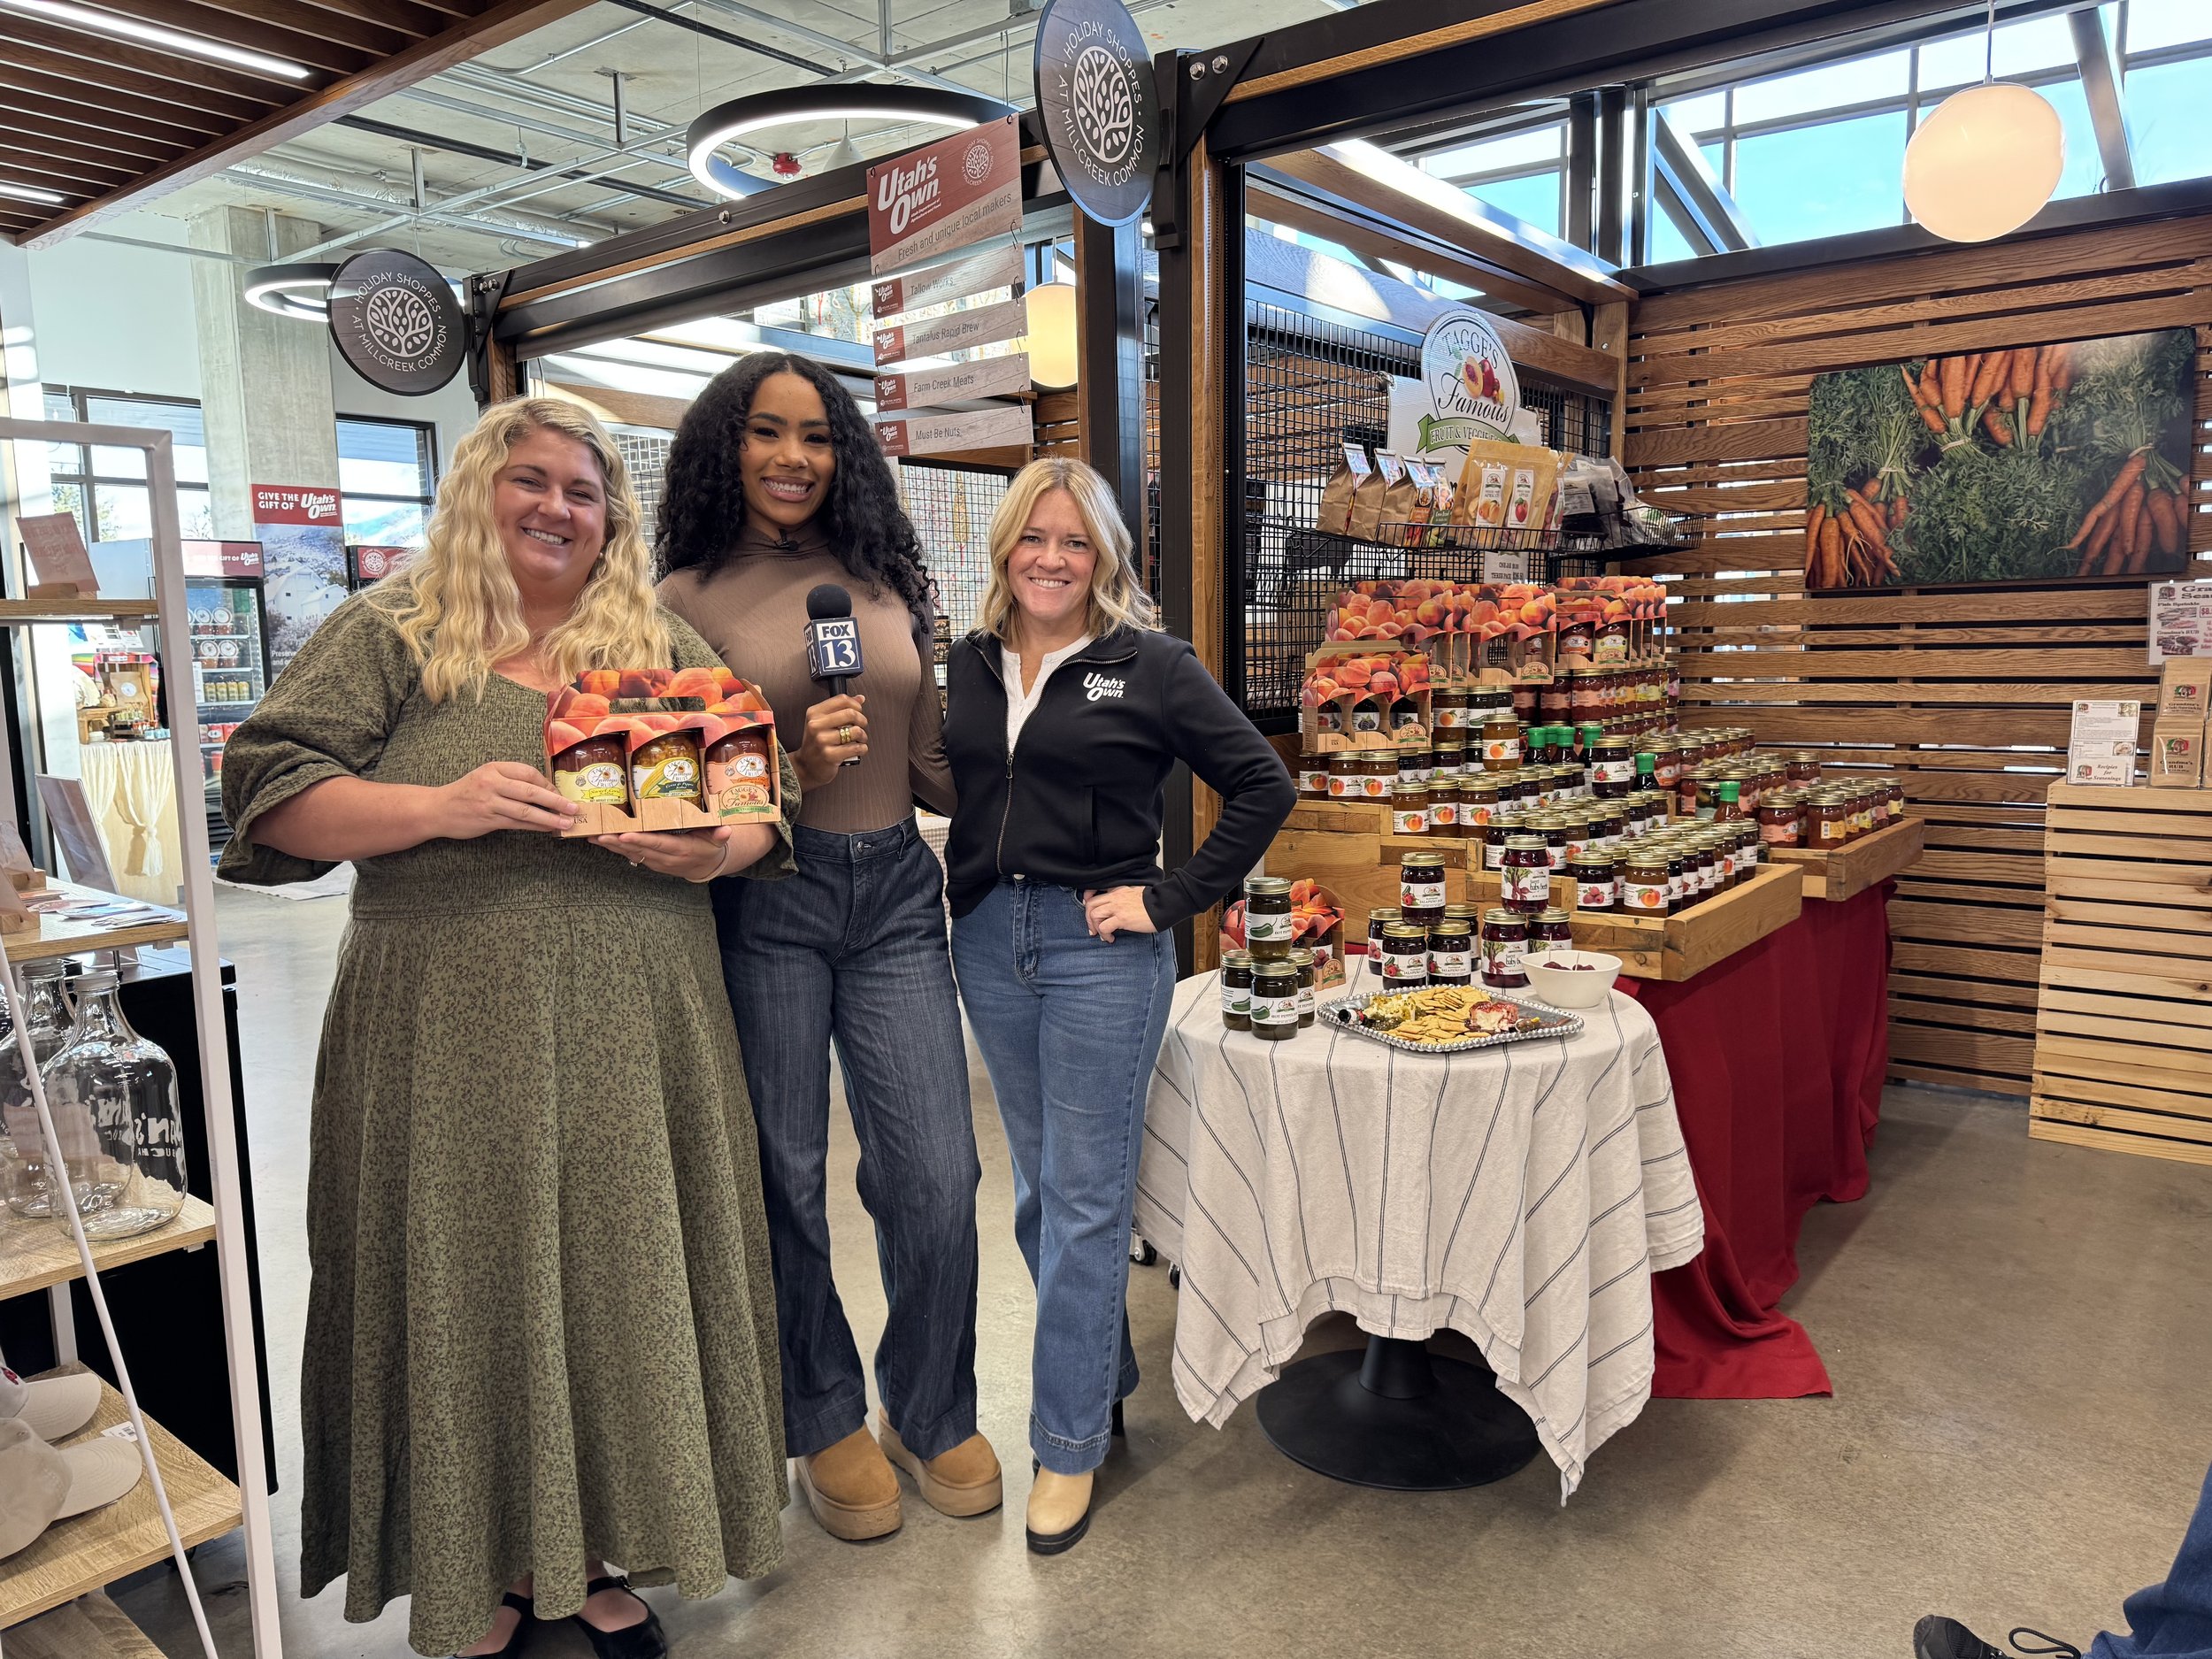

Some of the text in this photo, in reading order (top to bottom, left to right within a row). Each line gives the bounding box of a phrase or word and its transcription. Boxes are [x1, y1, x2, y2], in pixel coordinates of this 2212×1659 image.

[1064, 21, 1142, 104] HOLIDAY SHOPPES
[1059, 74, 1144, 186] AT MILLCREEK COMMON
[878, 156, 937, 211] Utah's
[890, 178, 939, 234] Own
[898, 193, 1011, 261] Fresh and unique local makers
[354, 272, 441, 312] HOLIDAY SHOPPES
[910, 276, 954, 296] Tallow Works
[912, 323, 979, 344] Tantalus Rapid Brew
[352, 315, 446, 372] AT MILLCREEK COMMON
[1443, 329, 1499, 369] TAGGE'S
[914, 375, 974, 393] Farm Creek Meats
[1438, 373, 1509, 422] Famous
[915, 426, 961, 441] Must Be Nuts
[1431, 426, 1453, 443] FRUIT
[1455, 426, 1461, 439] &
[257, 491, 299, 502] GIVE THE
[258, 501, 280, 510] GIFT
[301, 493, 335, 508] Utah's
[308, 504, 336, 519] Own
[822, 625, 850, 638] FOX
[822, 640, 856, 668] 13
[1083, 672, 1125, 689] Utah's
[1087, 687, 1124, 702] Own
[729, 787, 758, 795] TAGGE'S
[726, 797, 764, 807] Famous
